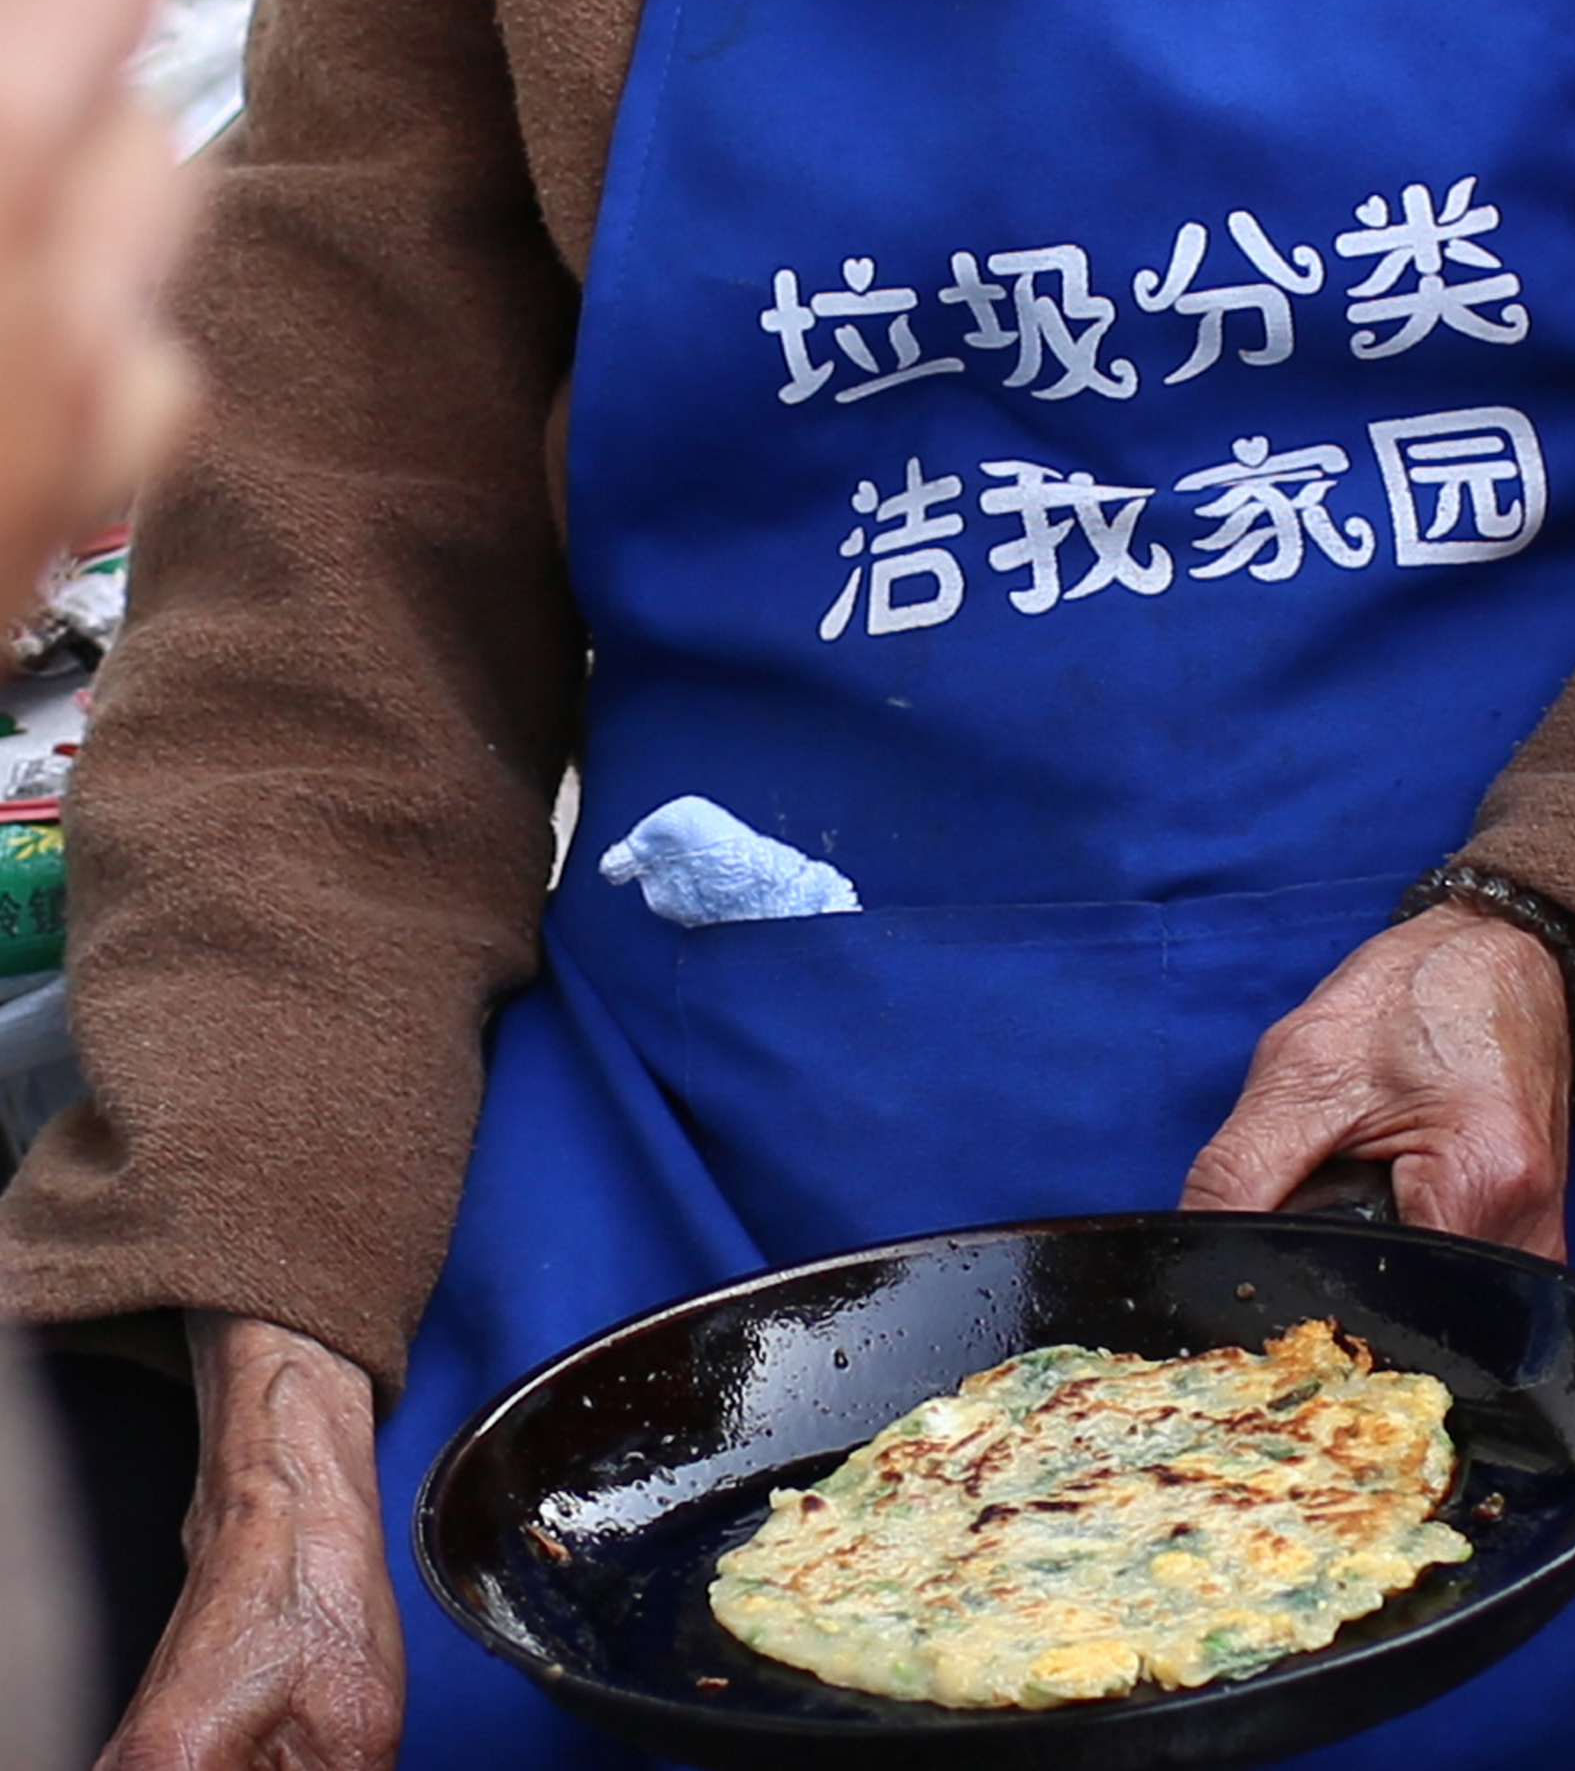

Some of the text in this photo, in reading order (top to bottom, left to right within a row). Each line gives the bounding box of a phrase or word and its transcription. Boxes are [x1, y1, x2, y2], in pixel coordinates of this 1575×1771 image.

[760, 176, 1530, 405] 垃圾分类
[819, 406, 1547, 641] 洁我家园
